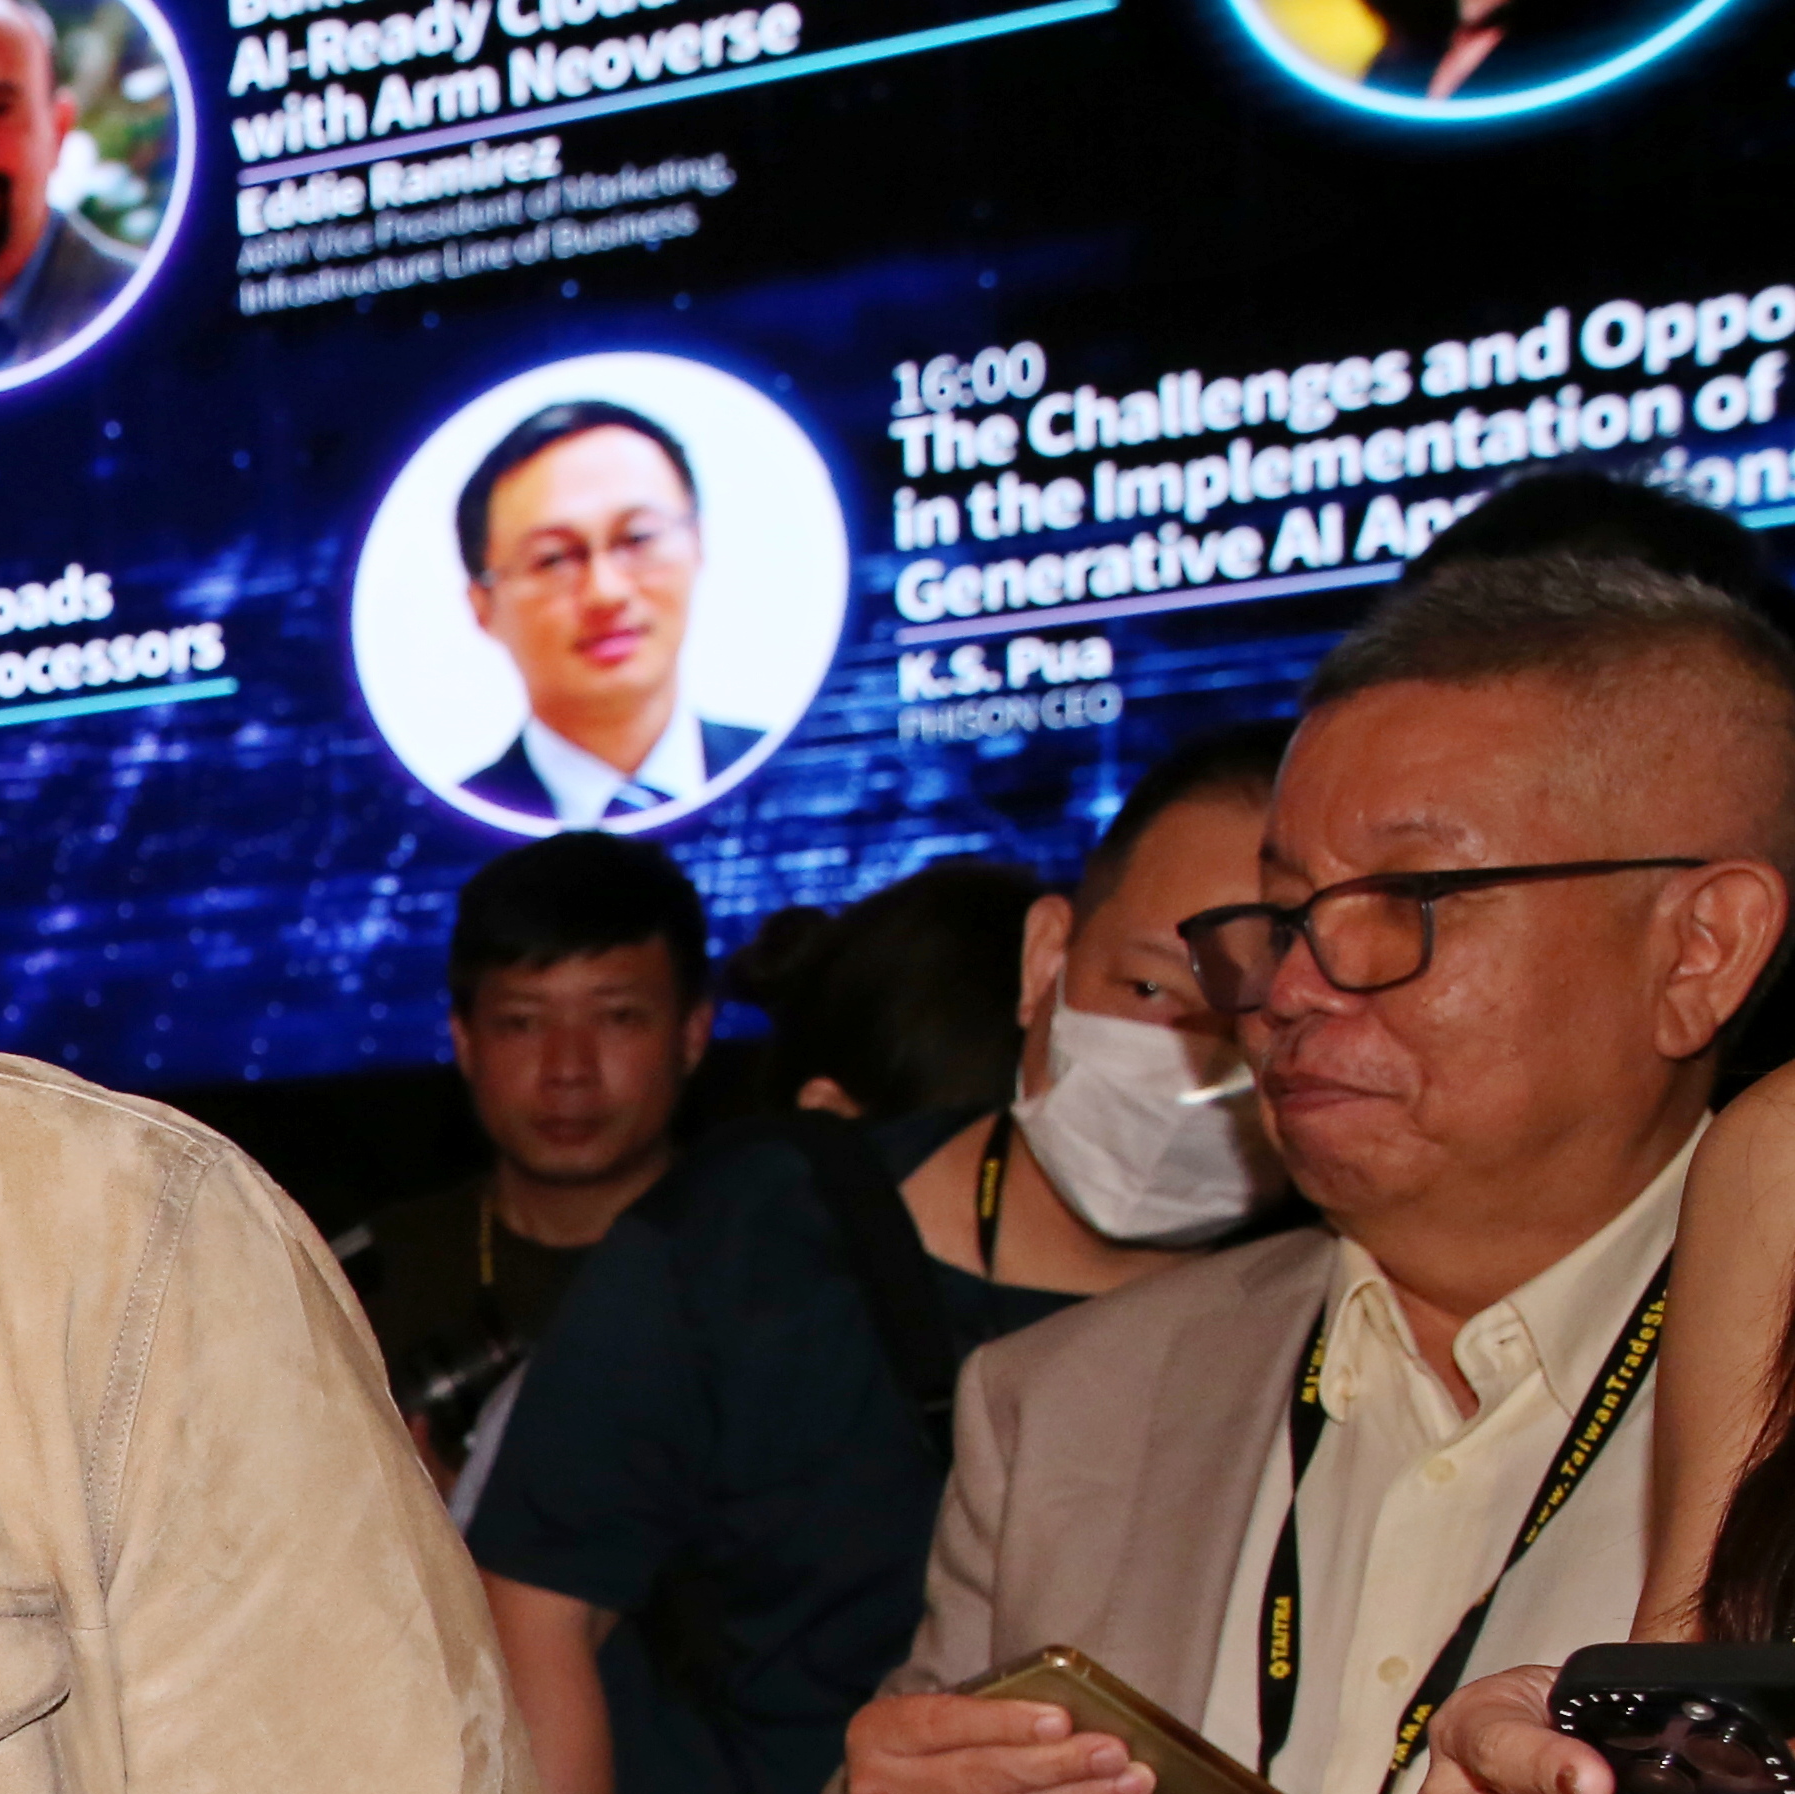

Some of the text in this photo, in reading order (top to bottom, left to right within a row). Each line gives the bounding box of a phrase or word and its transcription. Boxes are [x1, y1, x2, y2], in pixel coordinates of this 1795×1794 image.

[228, 0, 493, 97] AI-Ready
[232, 1, 803, 163] with Arm Neoverse
[237, 134, 563, 237] Eddie Ramirez
[888, 411, 1020, 479] The
[1026, 349, 1413, 458] Challenges
[1421, 306, 1571, 398] and
[891, 340, 1047, 417] 16:00
[893, 485, 961, 552] in
[966, 469, 1086, 542] the
[1093, 383, 1685, 523] Implementation
[1693, 349, 1789, 432] of
[894, 521, 1266, 624] Generative
[1268, 502, 1346, 573] AI
[897, 635, 1114, 703] K.S. Pua
[1040, 682, 1124, 730] CEO
